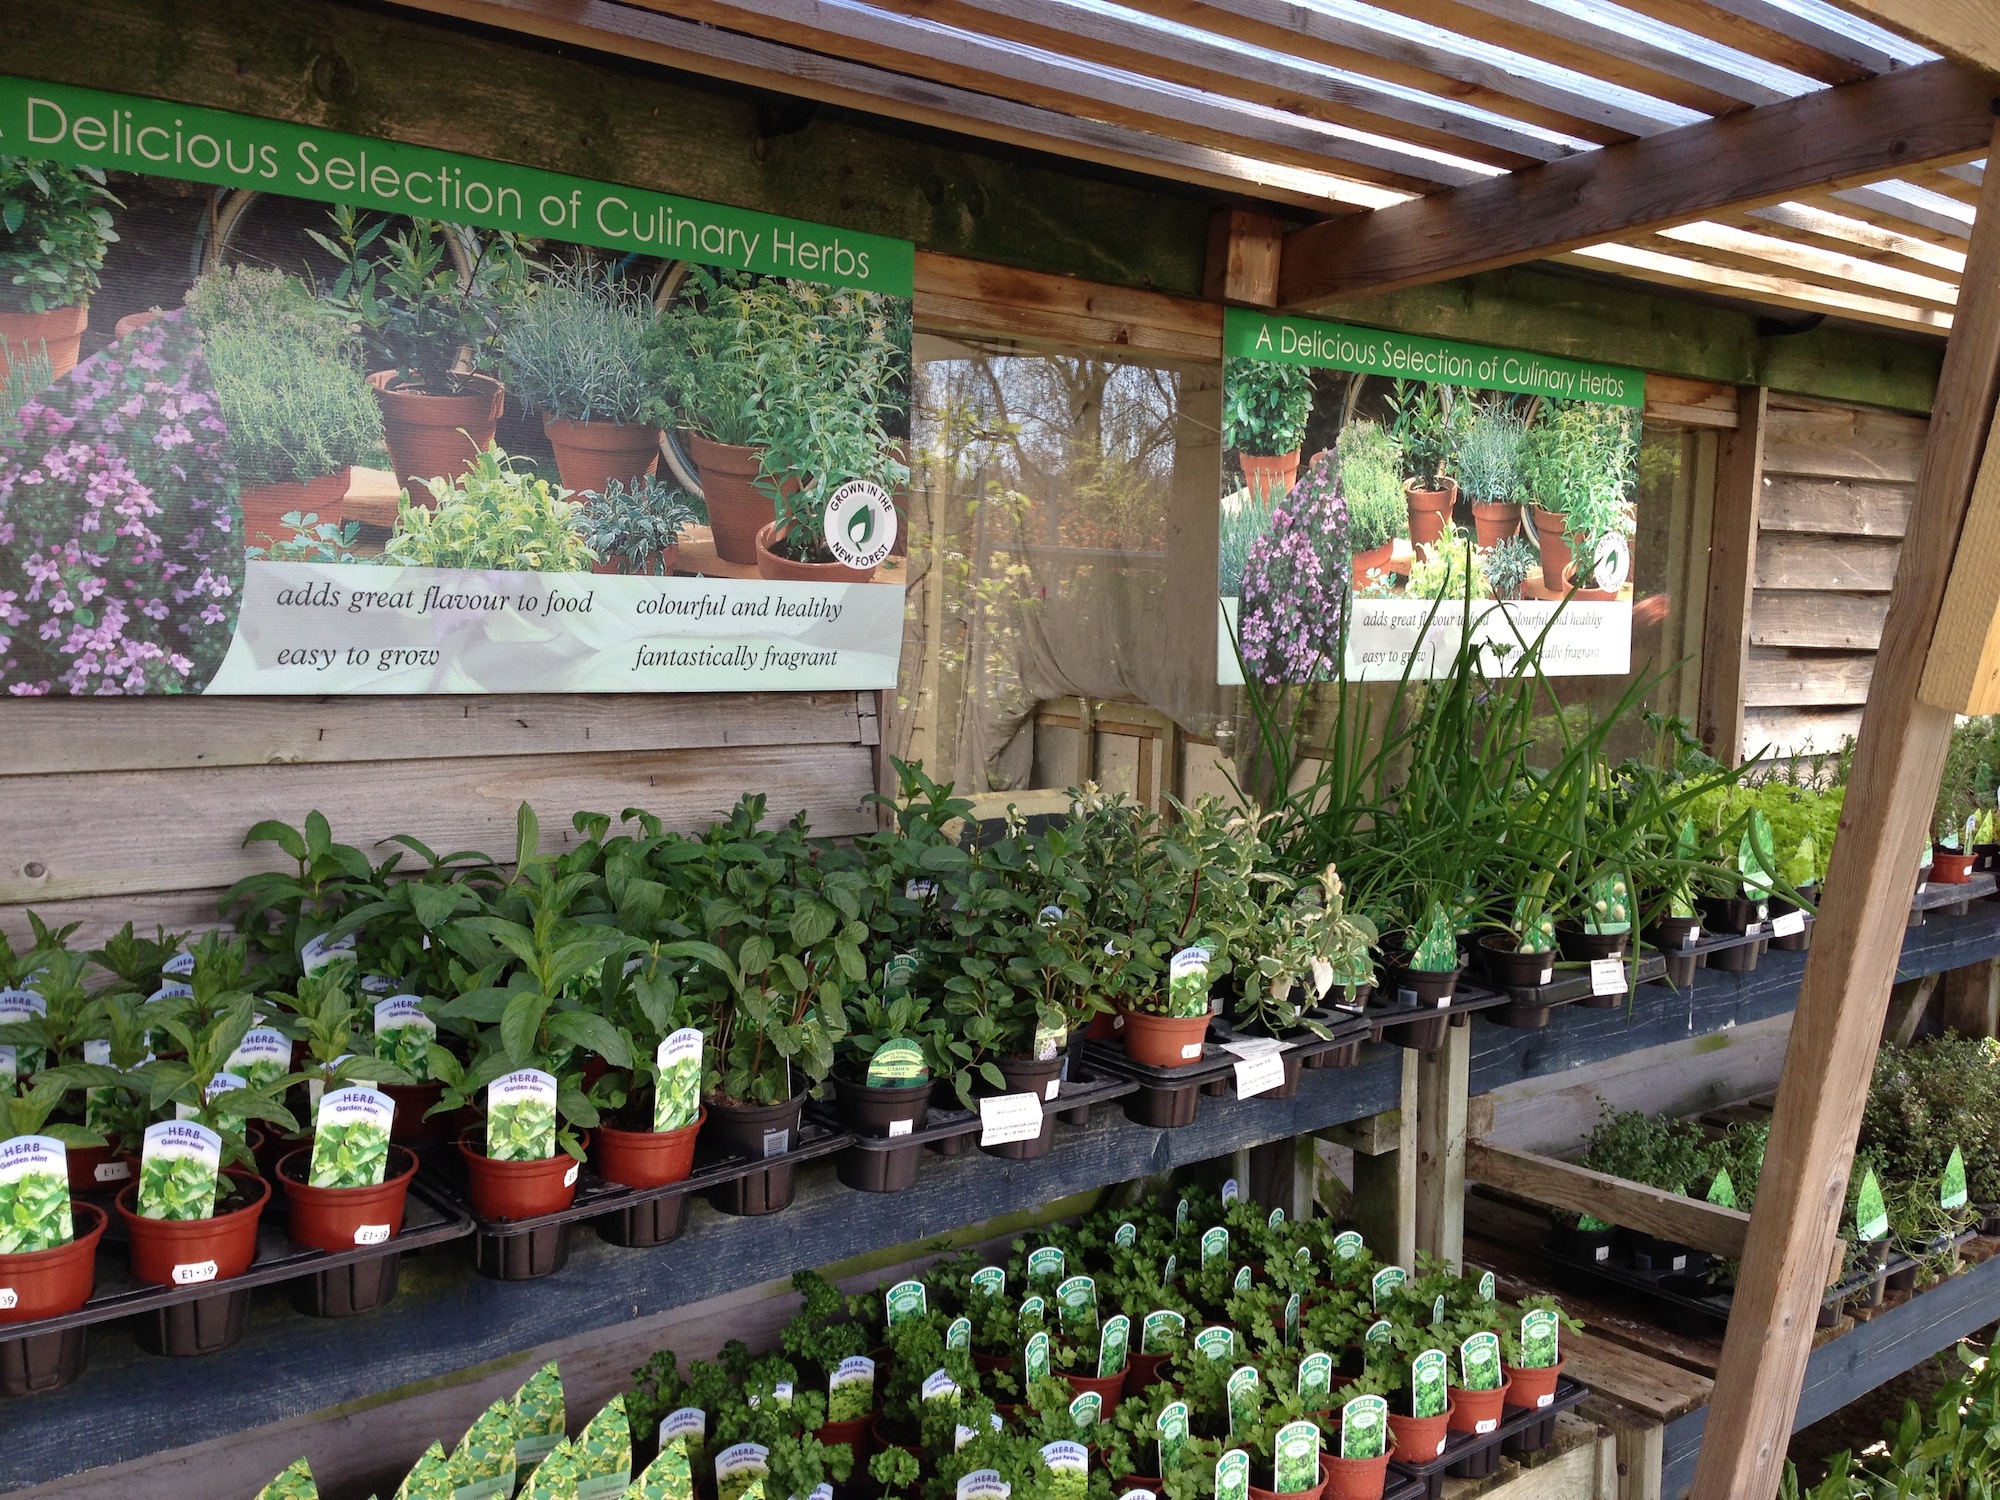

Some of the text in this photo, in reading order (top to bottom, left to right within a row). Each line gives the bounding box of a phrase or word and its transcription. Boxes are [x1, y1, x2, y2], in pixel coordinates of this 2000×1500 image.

[27, 97, 870, 279] Delicious Selection of Culinary Herbs
[1255, 323, 1624, 398] A Delicious Selection of Culinary Herbs
[830, 482, 893, 513] GROWN IN THE
[832, 541, 889, 567] NEW FOREST
[277, 582, 593, 617] adds great flavour to food
[636, 593, 842, 622] colourful and healthy
[1363, 611, 1388, 626] adds
[1390, 614, 1416, 630] great
[1417, 611, 1455, 629] flvour
[1570, 612, 1602, 629] healthy
[277, 645, 440, 671] easy to grow
[632, 644, 838, 671] fantastically fragrant
[1362, 650, 1426, 666] easy to grw
[1564, 645, 1600, 662] fragrant
[1183, 952, 1199, 960] HERB
[4, 997, 31, 1005] HERB
[393, 1001, 414, 1009] HER
[389, 1010, 410, 1018] Garden
[246, 1035, 275, 1045] HERB
[672, 1034, 692, 1045] HERB
[240, 1045, 264, 1054] Garden
[509, 1074, 538, 1083] HERB
[343, 1093, 375, 1104] HERB
[363, 1107, 378, 1115] Mint
[168, 1127, 201, 1139] HERB
[161, 1138, 205, 1151] Garden Mint
[4, 1143, 40, 1157] HERB
[0, 1155, 48, 1169] Garden Mint
[1038, 1251, 1055, 1259] HERB
[980, 1271, 996, 1280] HERB
[1382, 1271, 1397, 1279] HERB
[895, 1285, 914, 1295] HERB
[1066, 1280, 1084, 1290] HERB
[1531, 1312, 1548, 1320] HERB
[1111, 1320, 1123, 1329] HERB
[1205, 1331, 1223, 1340] HERB
[1470, 1336, 1488, 1345] HERB
[1308, 1356, 1322, 1367] HERB
[1421, 1354, 1437, 1364] HERB
[1235, 1371, 1249, 1383] HERB
[1078, 1396, 1093, 1407] HERB
[1355, 1400, 1374, 1408] HERB
[674, 1413, 694, 1422] HERB
[1164, 1407, 1179, 1420] HERB
[668, 1422, 683, 1432] Curled
[1287, 1427, 1307, 1437] HERB
[731, 1448, 754, 1458] HERB
[1052, 1446, 1074, 1455] HERB
[726, 1458, 742, 1467] Curled
[1046, 1454, 1080, 1464] Curled Parsley
[1225, 1456, 1240, 1466] HERB
[604, 1475, 624, 1485] Balm
[974, 1475, 998, 1484] HERB
[967, 1484, 1002, 1493] Curled Parsley
